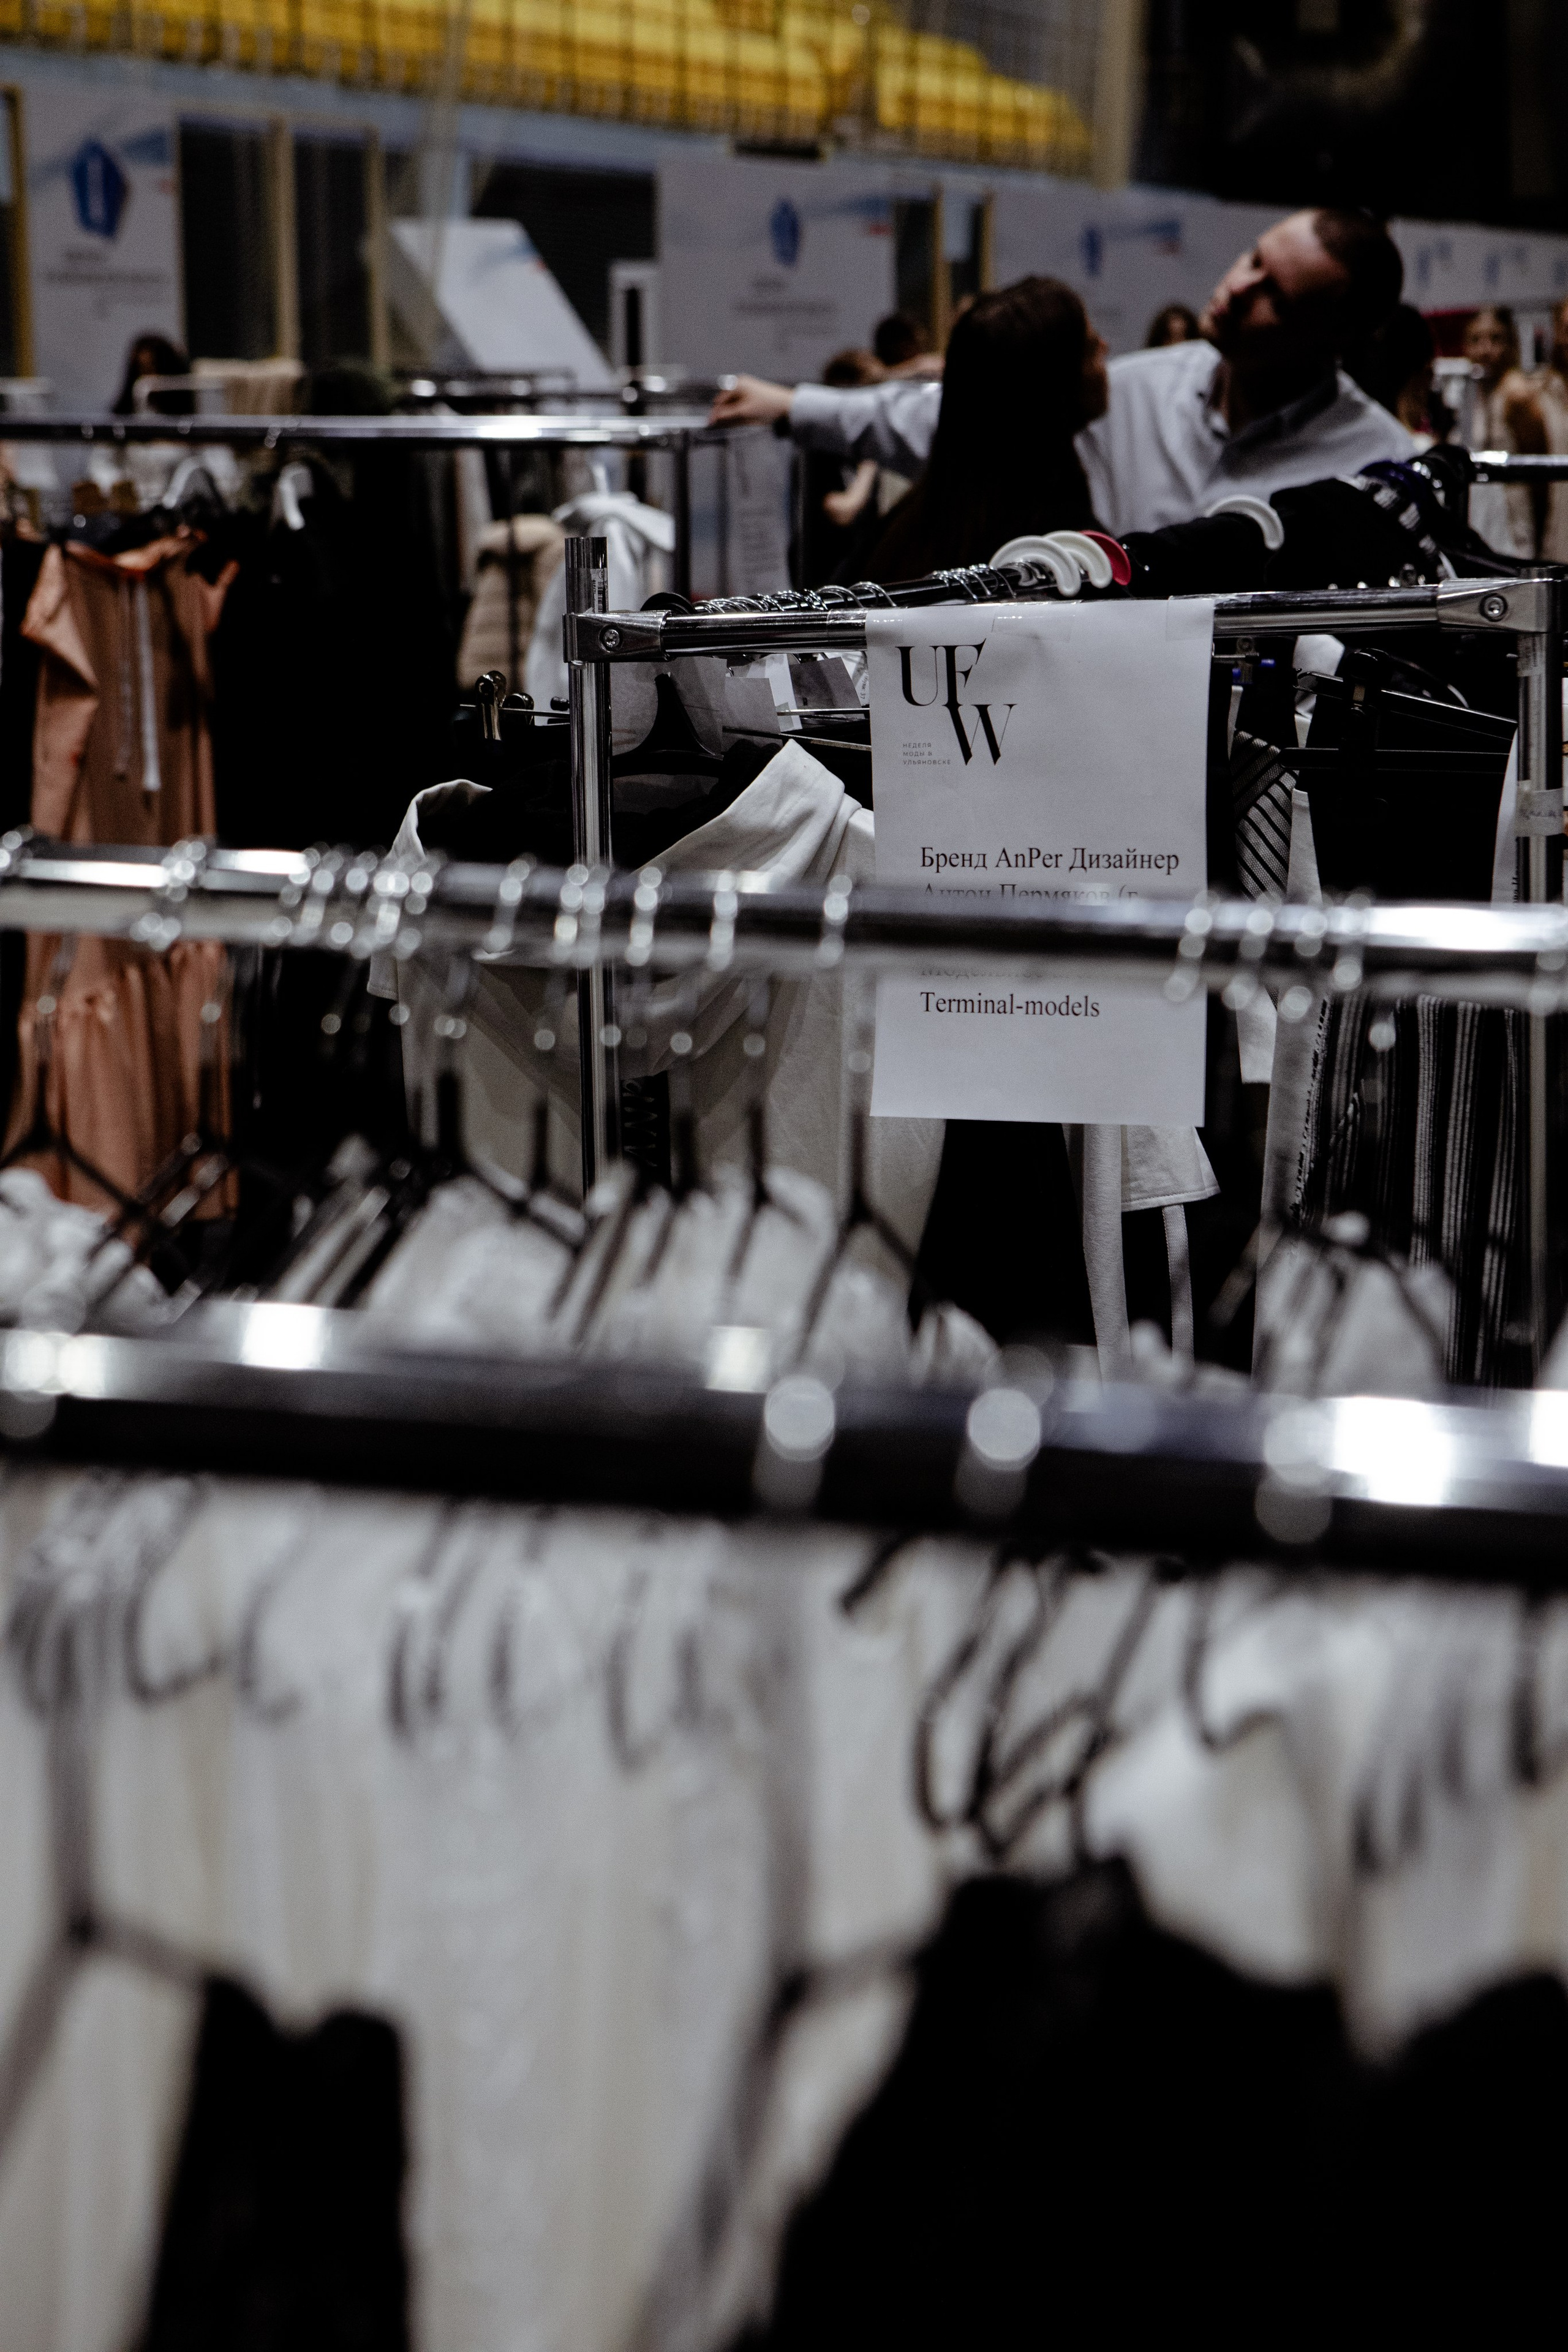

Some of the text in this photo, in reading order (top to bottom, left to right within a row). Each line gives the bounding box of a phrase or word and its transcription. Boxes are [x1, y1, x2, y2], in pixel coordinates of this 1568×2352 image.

[921, 847, 1179, 875] Бренд AnPer Дизайнер
[920, 992, 1101, 1017] Terminal-models
